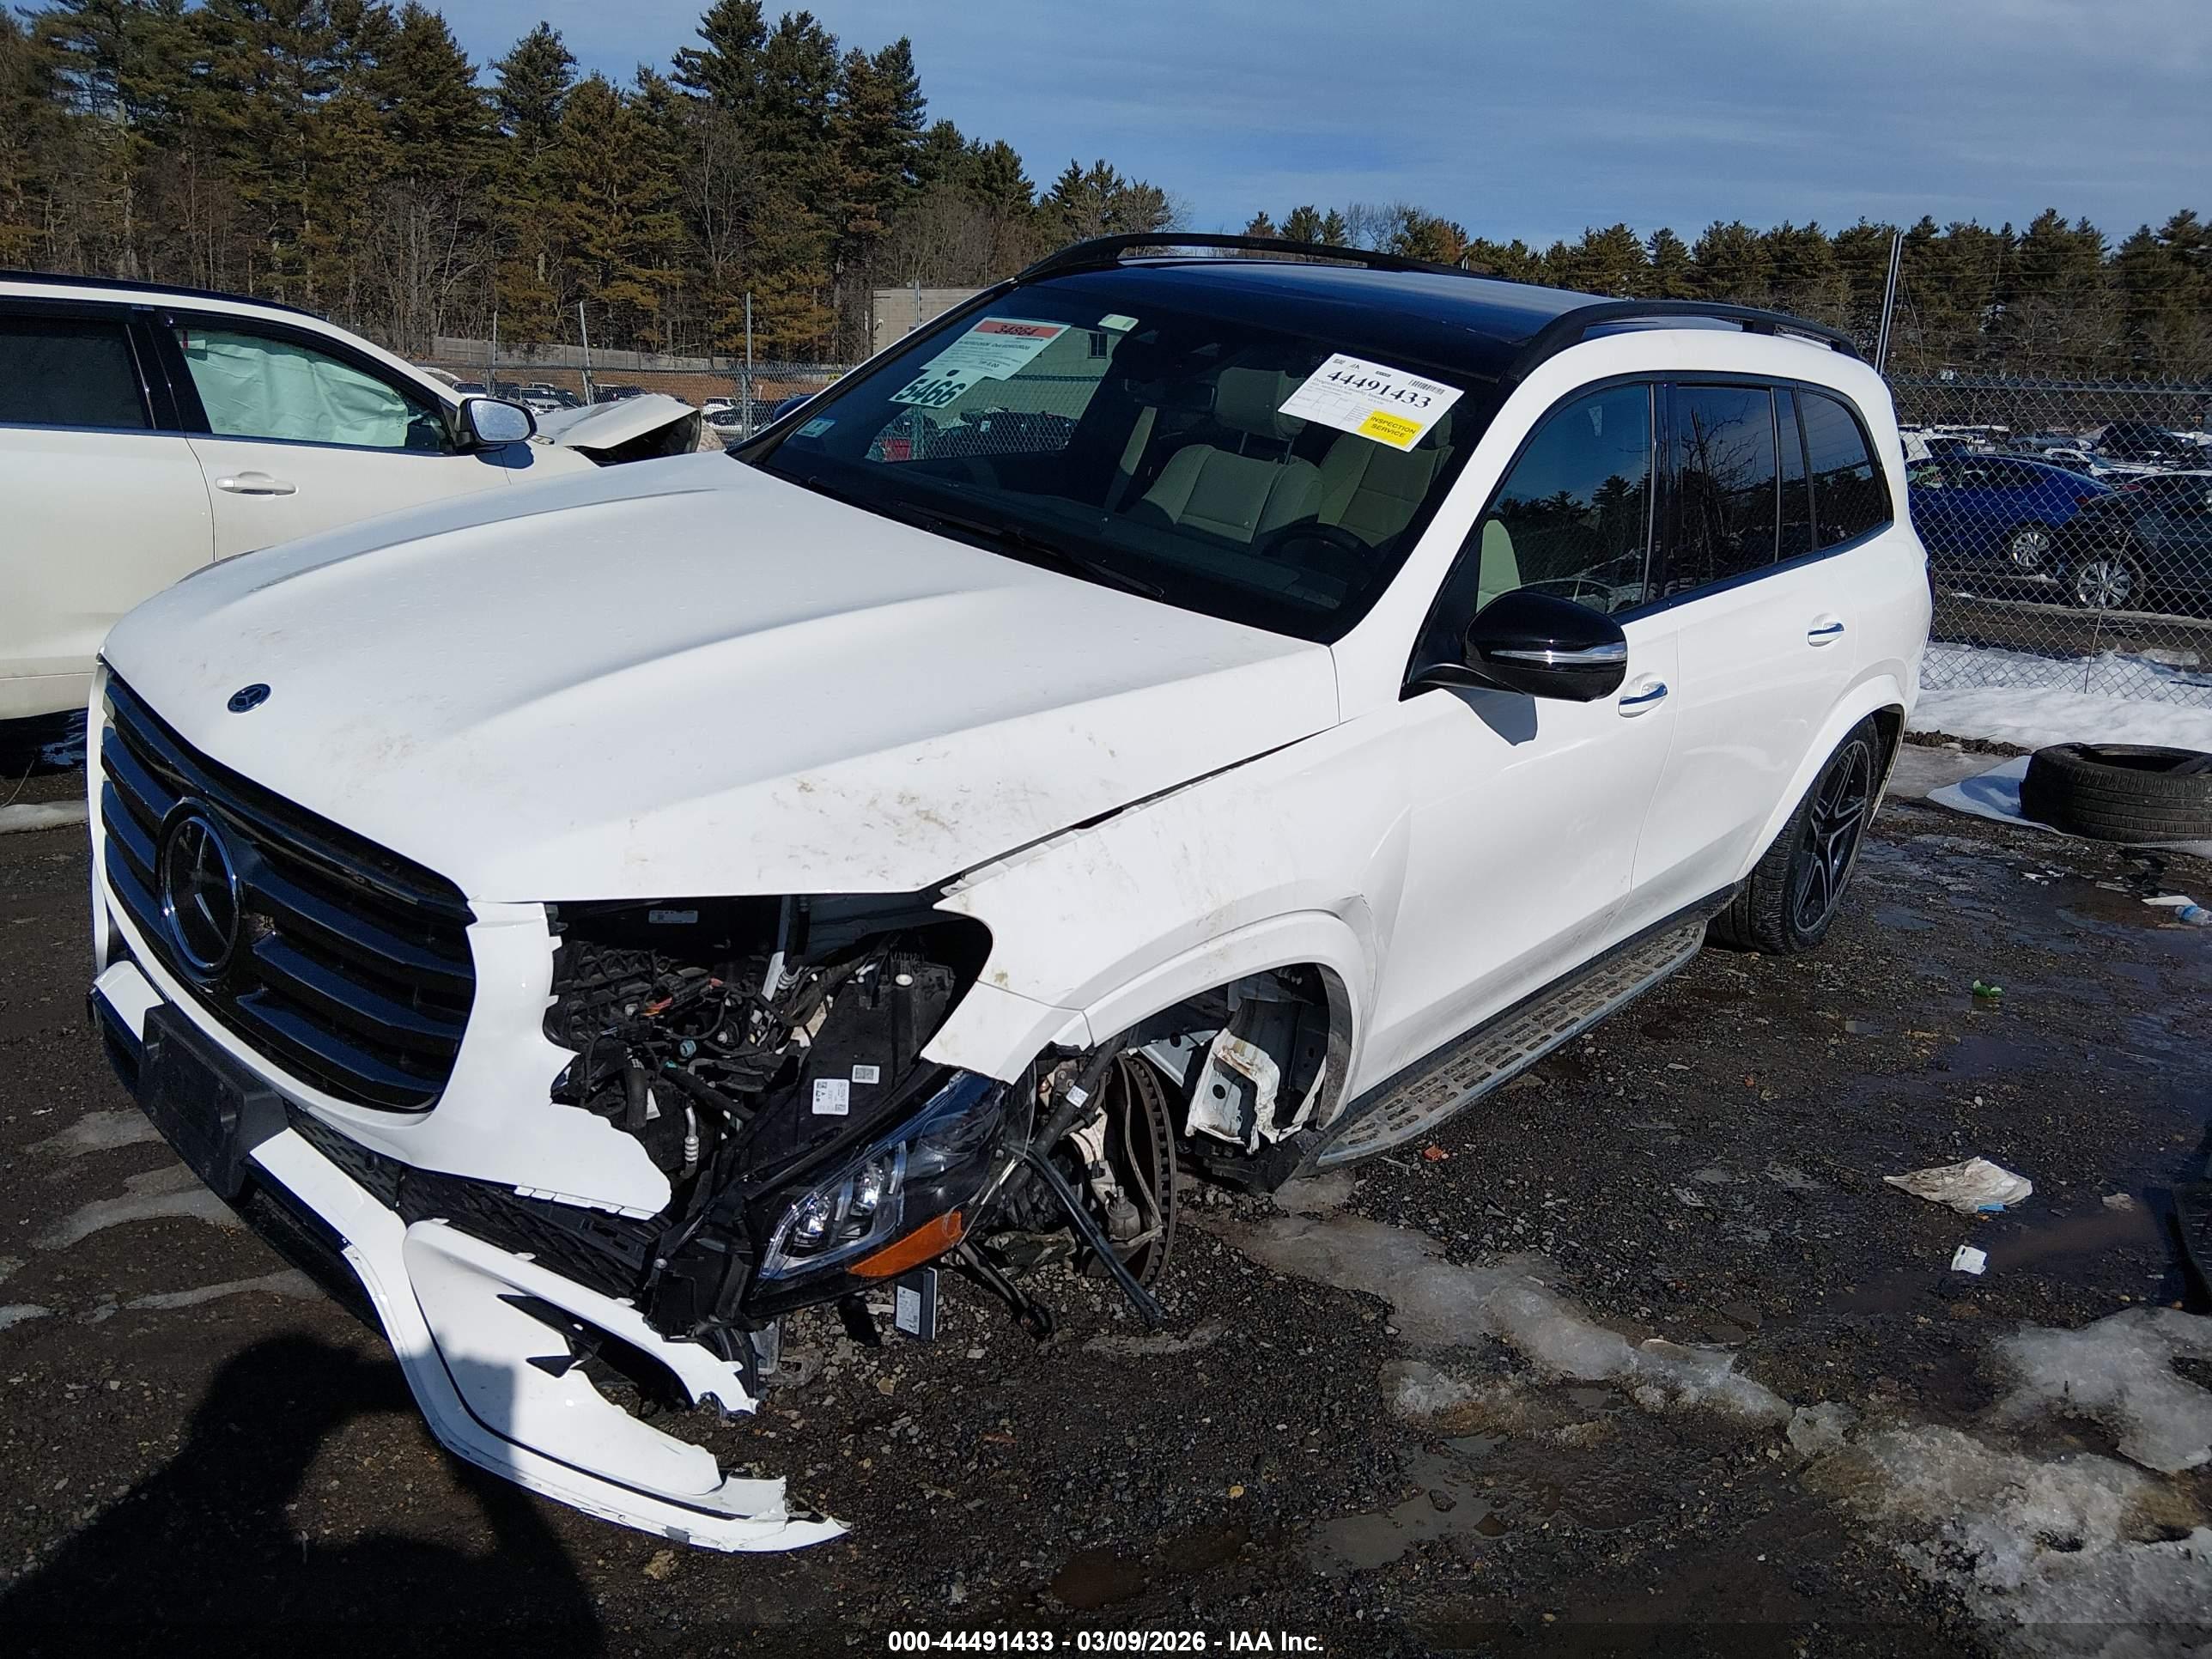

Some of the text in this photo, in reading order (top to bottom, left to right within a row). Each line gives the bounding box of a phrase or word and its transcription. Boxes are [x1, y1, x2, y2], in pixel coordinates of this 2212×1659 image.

[994, 325, 1039, 336] 34864
[895, 378, 967, 405] 5466
[1327, 370, 1432, 409] 44491433
[1370, 416, 1416, 434] INSPECTION
[1370, 423, 1407, 438] SERVICE
